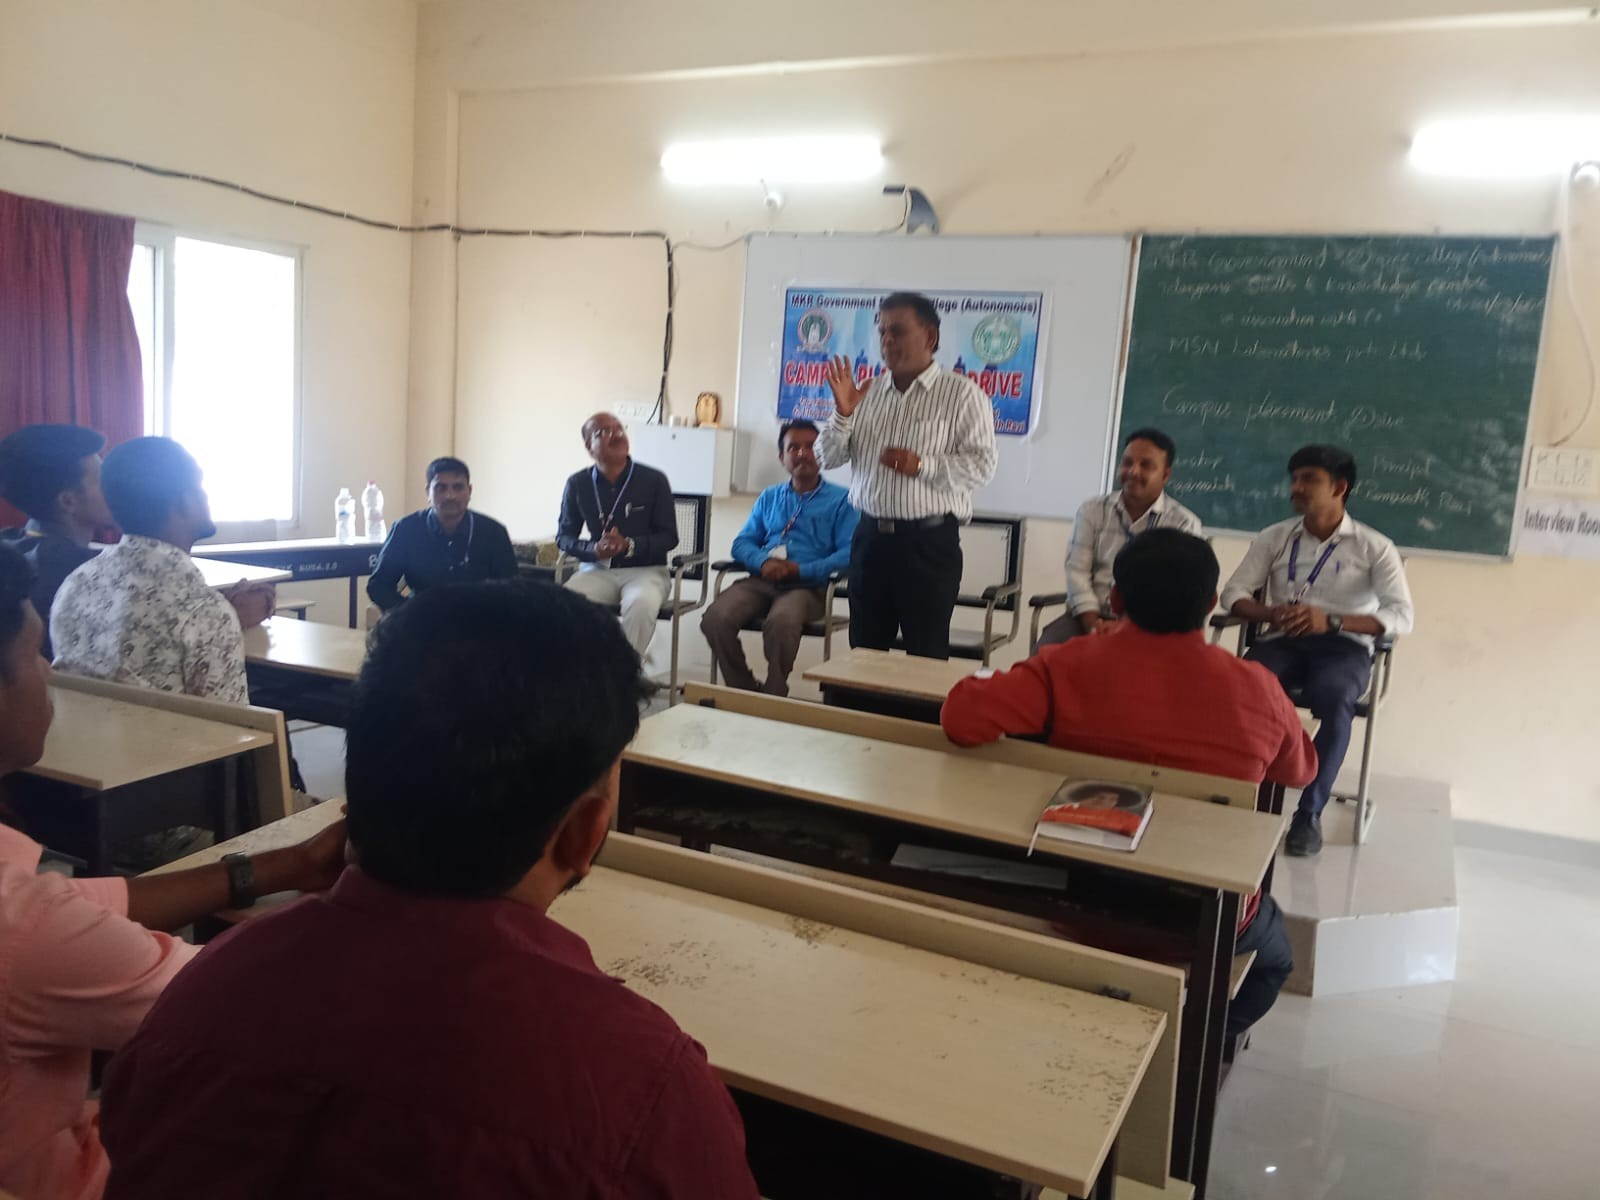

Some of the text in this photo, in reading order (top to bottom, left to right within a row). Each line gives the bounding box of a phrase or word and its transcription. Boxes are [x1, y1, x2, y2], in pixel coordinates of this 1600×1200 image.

[816, 295, 877, 310] Government
[961, 297, 1038, 318] (Autonomous)
[1523, 507, 1600, 536] Interview Roo
